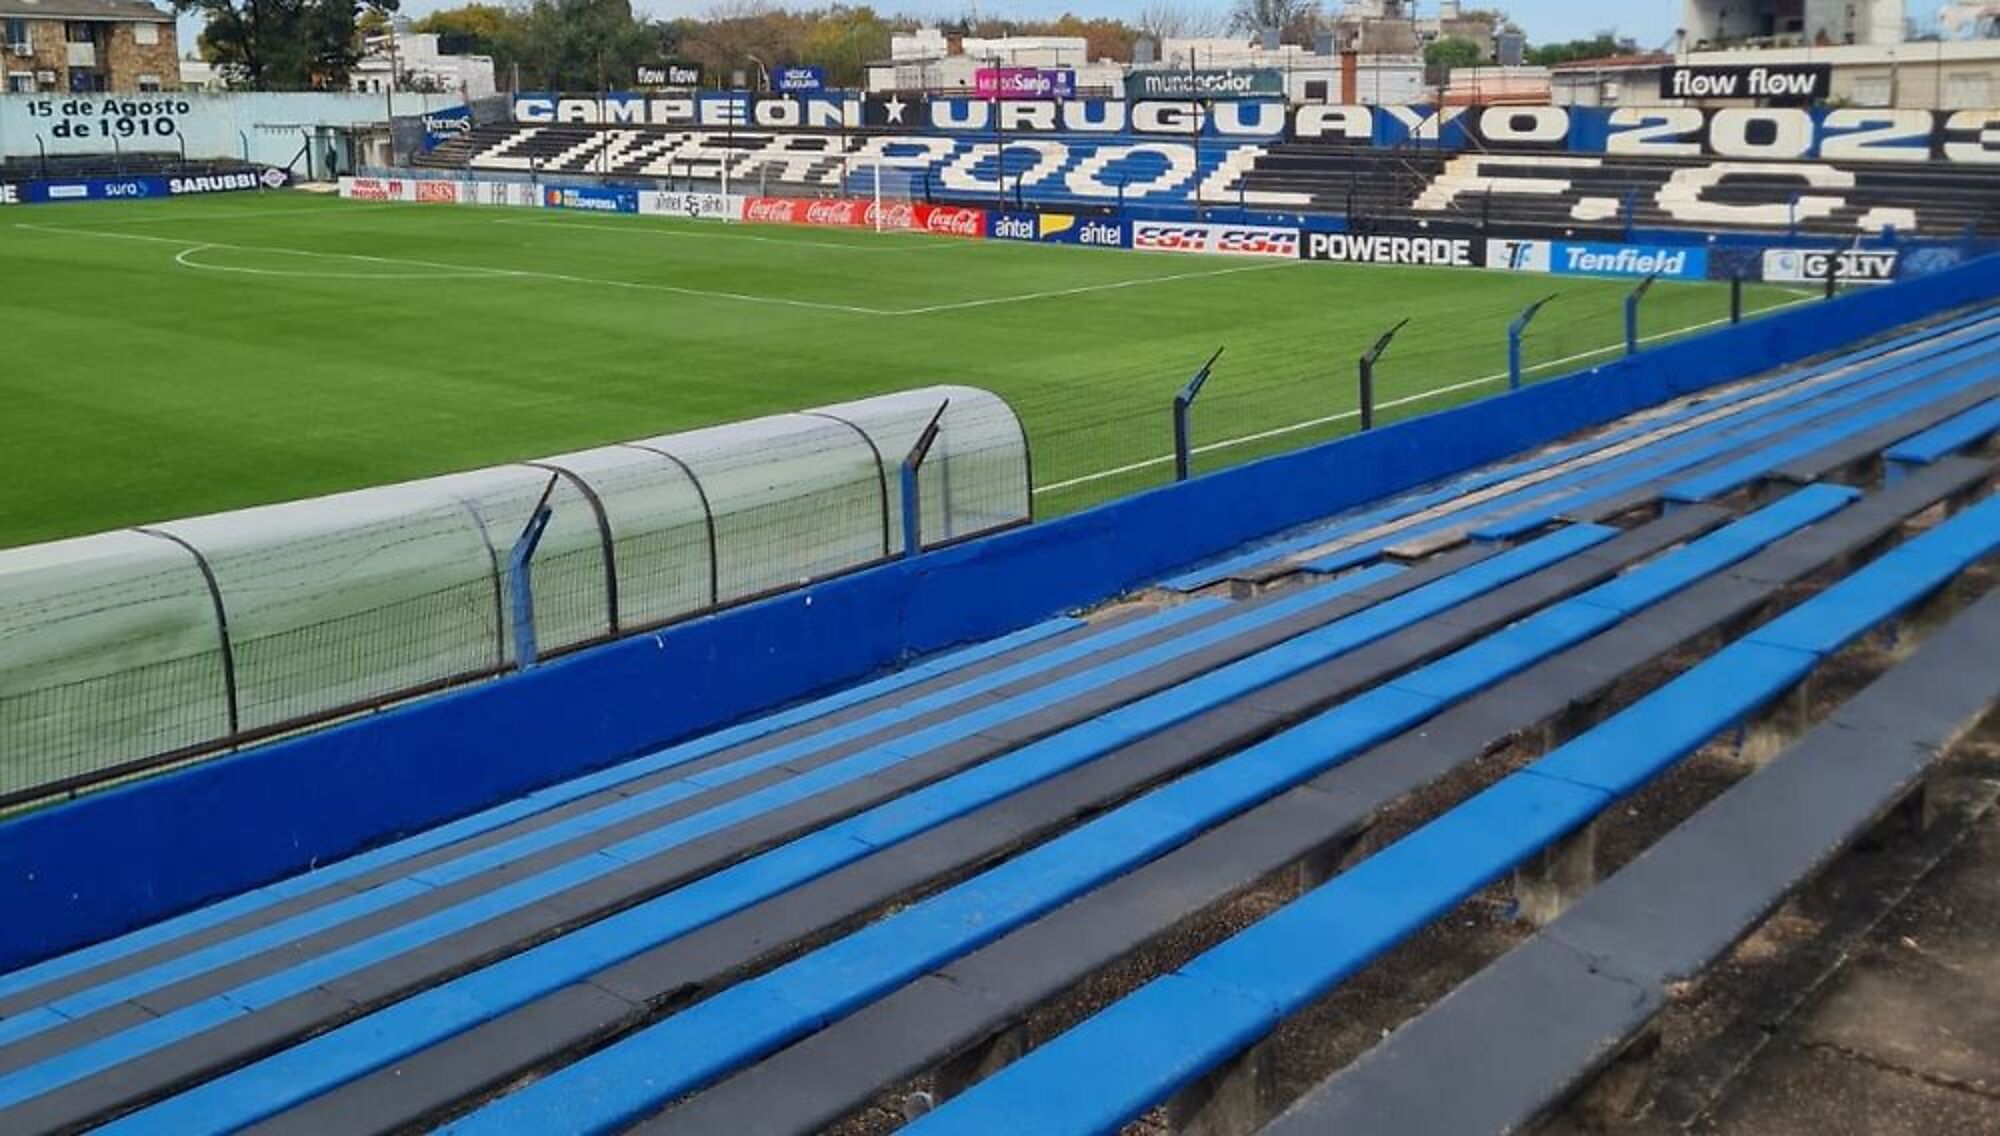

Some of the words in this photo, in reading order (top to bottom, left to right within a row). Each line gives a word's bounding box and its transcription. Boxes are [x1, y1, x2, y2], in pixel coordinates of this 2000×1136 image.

[1672, 69, 1737, 95] flow
[1748, 68, 1817, 94] flow
[27, 101, 53, 116] 15
[62, 100, 93, 116] de
[101, 100, 190, 117] Agosto
[931, 100, 1570, 141] URUGUAYO
[52, 119, 90, 137] de
[99, 117, 175, 137] 1910
[469, 128, 1312, 203] LIVERPOOL
[169, 173, 257, 194] SARUBBI
[807, 200, 854, 223] Coca-Cola
[928, 207, 979, 233] Coca-Cola
[995, 216, 1034, 239] antel
[1079, 222, 1121, 245] antel
[1309, 233, 1473, 265] POWERADE
[1565, 247, 1686, 274] Tenfield
